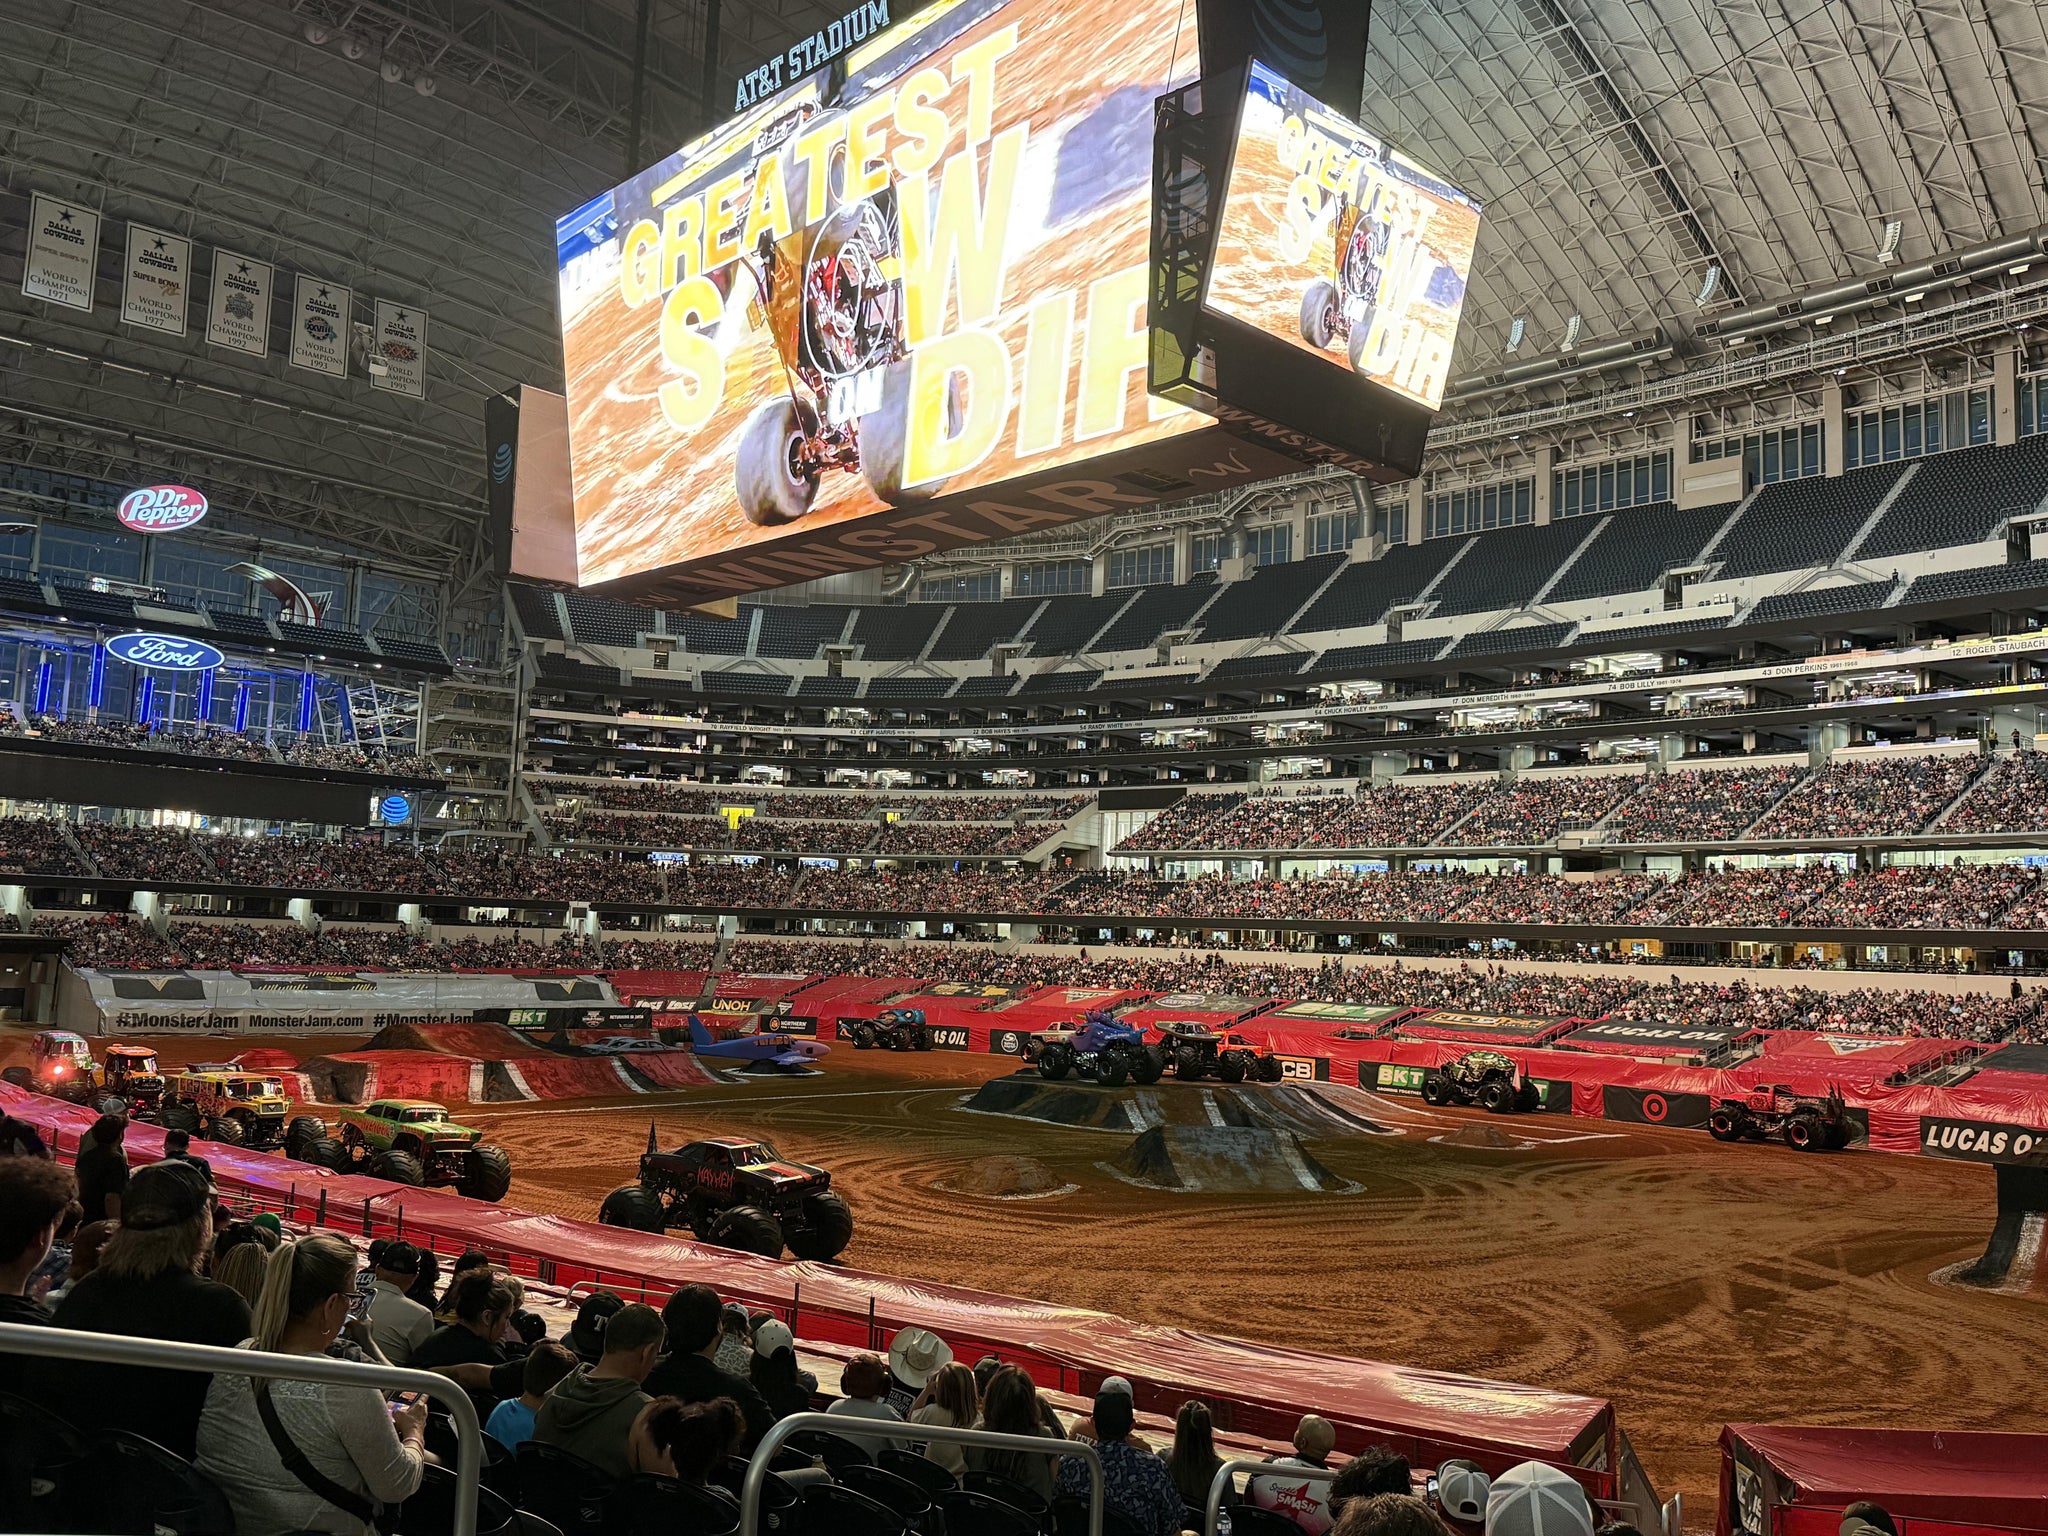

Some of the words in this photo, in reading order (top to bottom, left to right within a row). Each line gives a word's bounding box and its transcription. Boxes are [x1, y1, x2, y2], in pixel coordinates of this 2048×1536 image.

[734, 54, 784, 113] AT&T
[788, 0, 890, 80] STADIUM
[620, 19, 1024, 309] GREATEST
[1278, 116, 1438, 250] GREATEST
[43, 227, 85, 245] COWBOYS
[48, 221, 82, 236] DALLAS
[143, 249, 174, 263] DALLAS
[138, 256, 178, 272] COWBOYS
[42, 268, 78, 285] WORLD
[132, 270, 157, 283] SUPER
[158, 276, 181, 290] BOWL
[227, 273, 257, 287] DALLAS
[30, 274, 88, 297] CHAMPIONS
[223, 280, 260, 295] COWBOYS
[48, 289, 69, 301] 1971
[138, 296, 172, 311] WORLD
[309, 297, 337, 310] DALLAS
[127, 302, 182, 322] CHAMPIONS
[305, 304, 340, 319] COWBOYS
[144, 315, 165, 327] 1977
[222, 318, 254, 332] WORLD
[388, 321, 415, 333] DALLAS
[211, 323, 263, 343] CHAMPIONS
[227, 336, 247, 348] 1992
[305, 341, 335, 355] WORLD
[295, 347, 343, 366] CHAMPIONS
[310, 359, 328, 369] 1993
[390, 381, 407, 391] 1995
[1214, 405, 1374, 472] WINSTAR
[153, 488, 188, 507] Dr
[119, 488, 203, 526] Pepper
[668, 477, 1135, 590] WINSTAR
[127, 637, 205, 667] Ford
[1952, 648, 1962, 656] 12
[1966, 645, 1996, 655] ROGER
[1998, 639, 2046, 652] STAUBACH
[1776, 667, 1792, 675] DON
[1794, 663, 1828, 673] PERKINS
[1620, 682, 1635, 690] BOB
[1637, 680, 1655, 688] LILLY
[1476, 693, 1509, 702] MEREDITH
[1343, 705, 1368, 713] HOWLEY
[712, 999, 751, 1011] UNOH
[1284, 1002, 1394, 1017] BKT
[115, 1012, 239, 1029] #MonsterJam
[249, 1014, 364, 1029] MonsterJam.com
[508, 1009, 548, 1025] BKT
[1587, 1025, 1682, 1038] LUCAS
[1281, 1061, 1312, 1079] CB
[1377, 1064, 1424, 1088] BKT
[1926, 1125, 2008, 1154] LUCAS
[697, 1167, 735, 1192] MAYHEM
[718, 1224, 733, 1238] BKT
[1277, 1493, 1317, 1514] SMASH
